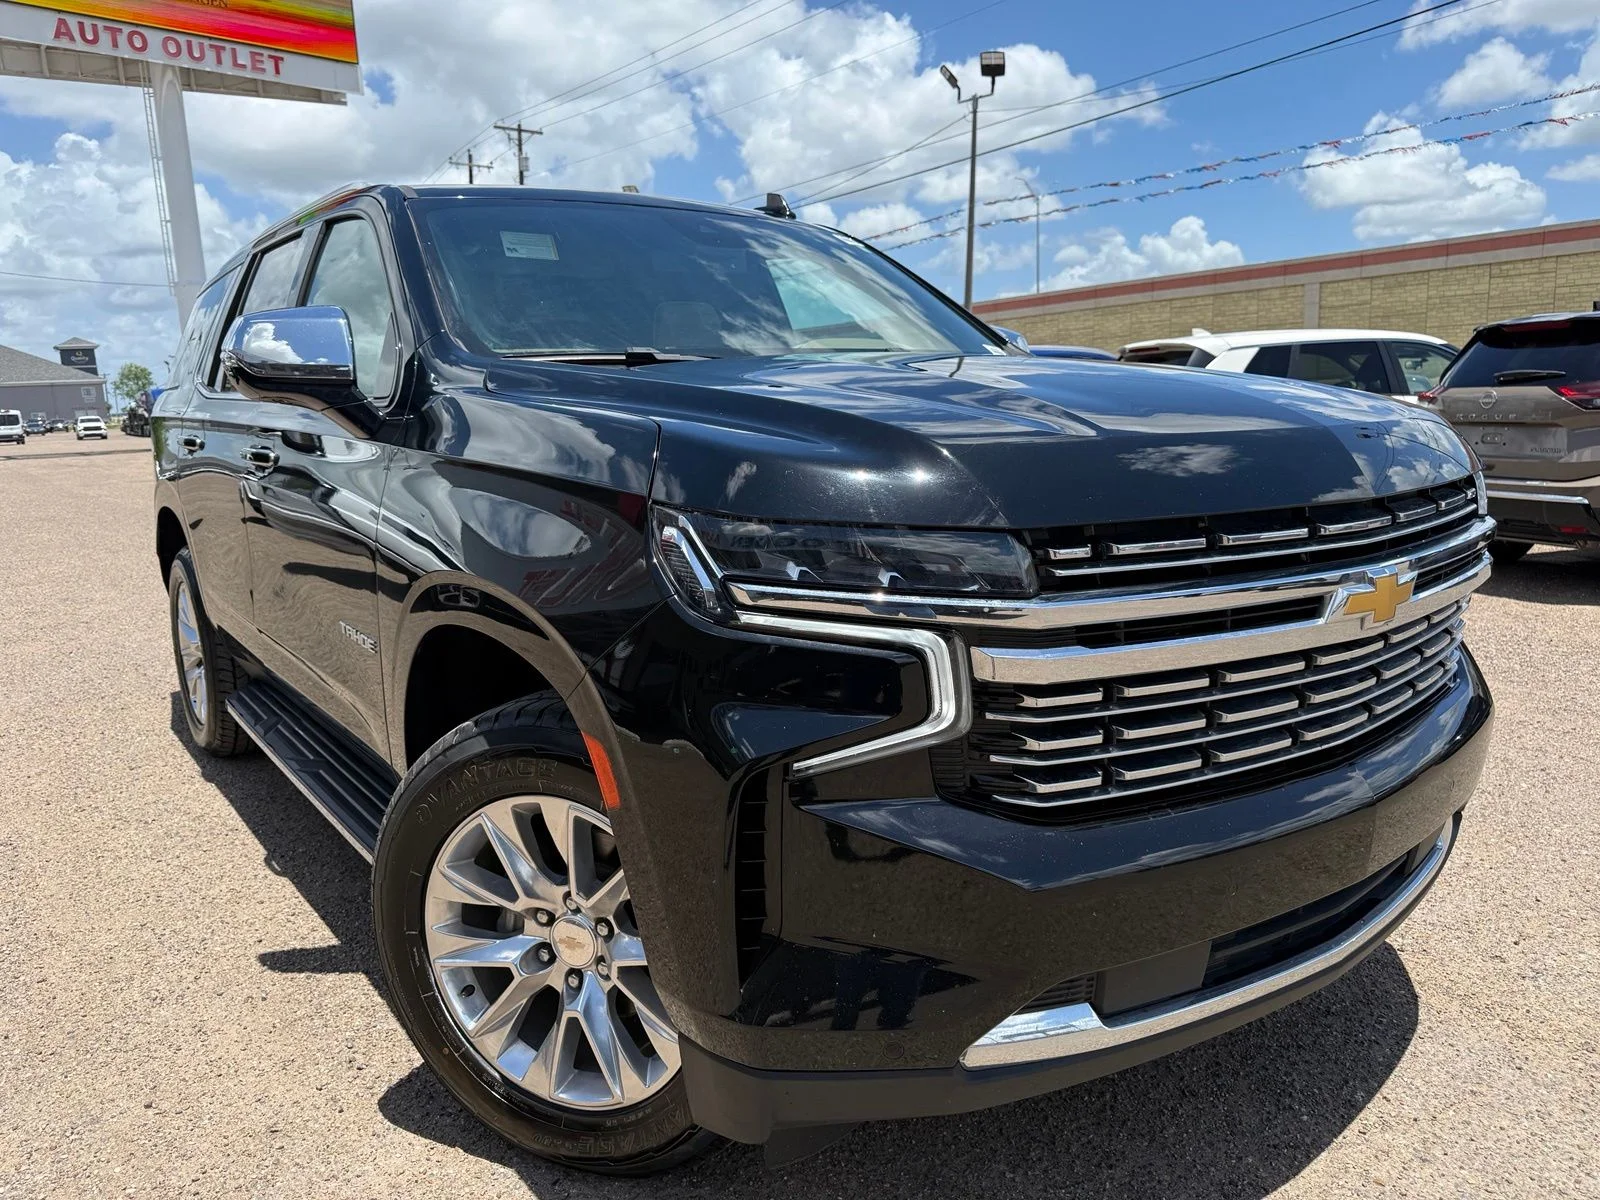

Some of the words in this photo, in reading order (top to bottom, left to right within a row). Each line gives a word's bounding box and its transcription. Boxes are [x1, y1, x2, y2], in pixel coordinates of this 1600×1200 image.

[53, 17, 148, 53] AUTO
[162, 36, 285, 76] OUTLET
[339, 621, 378, 654] TAHOE
